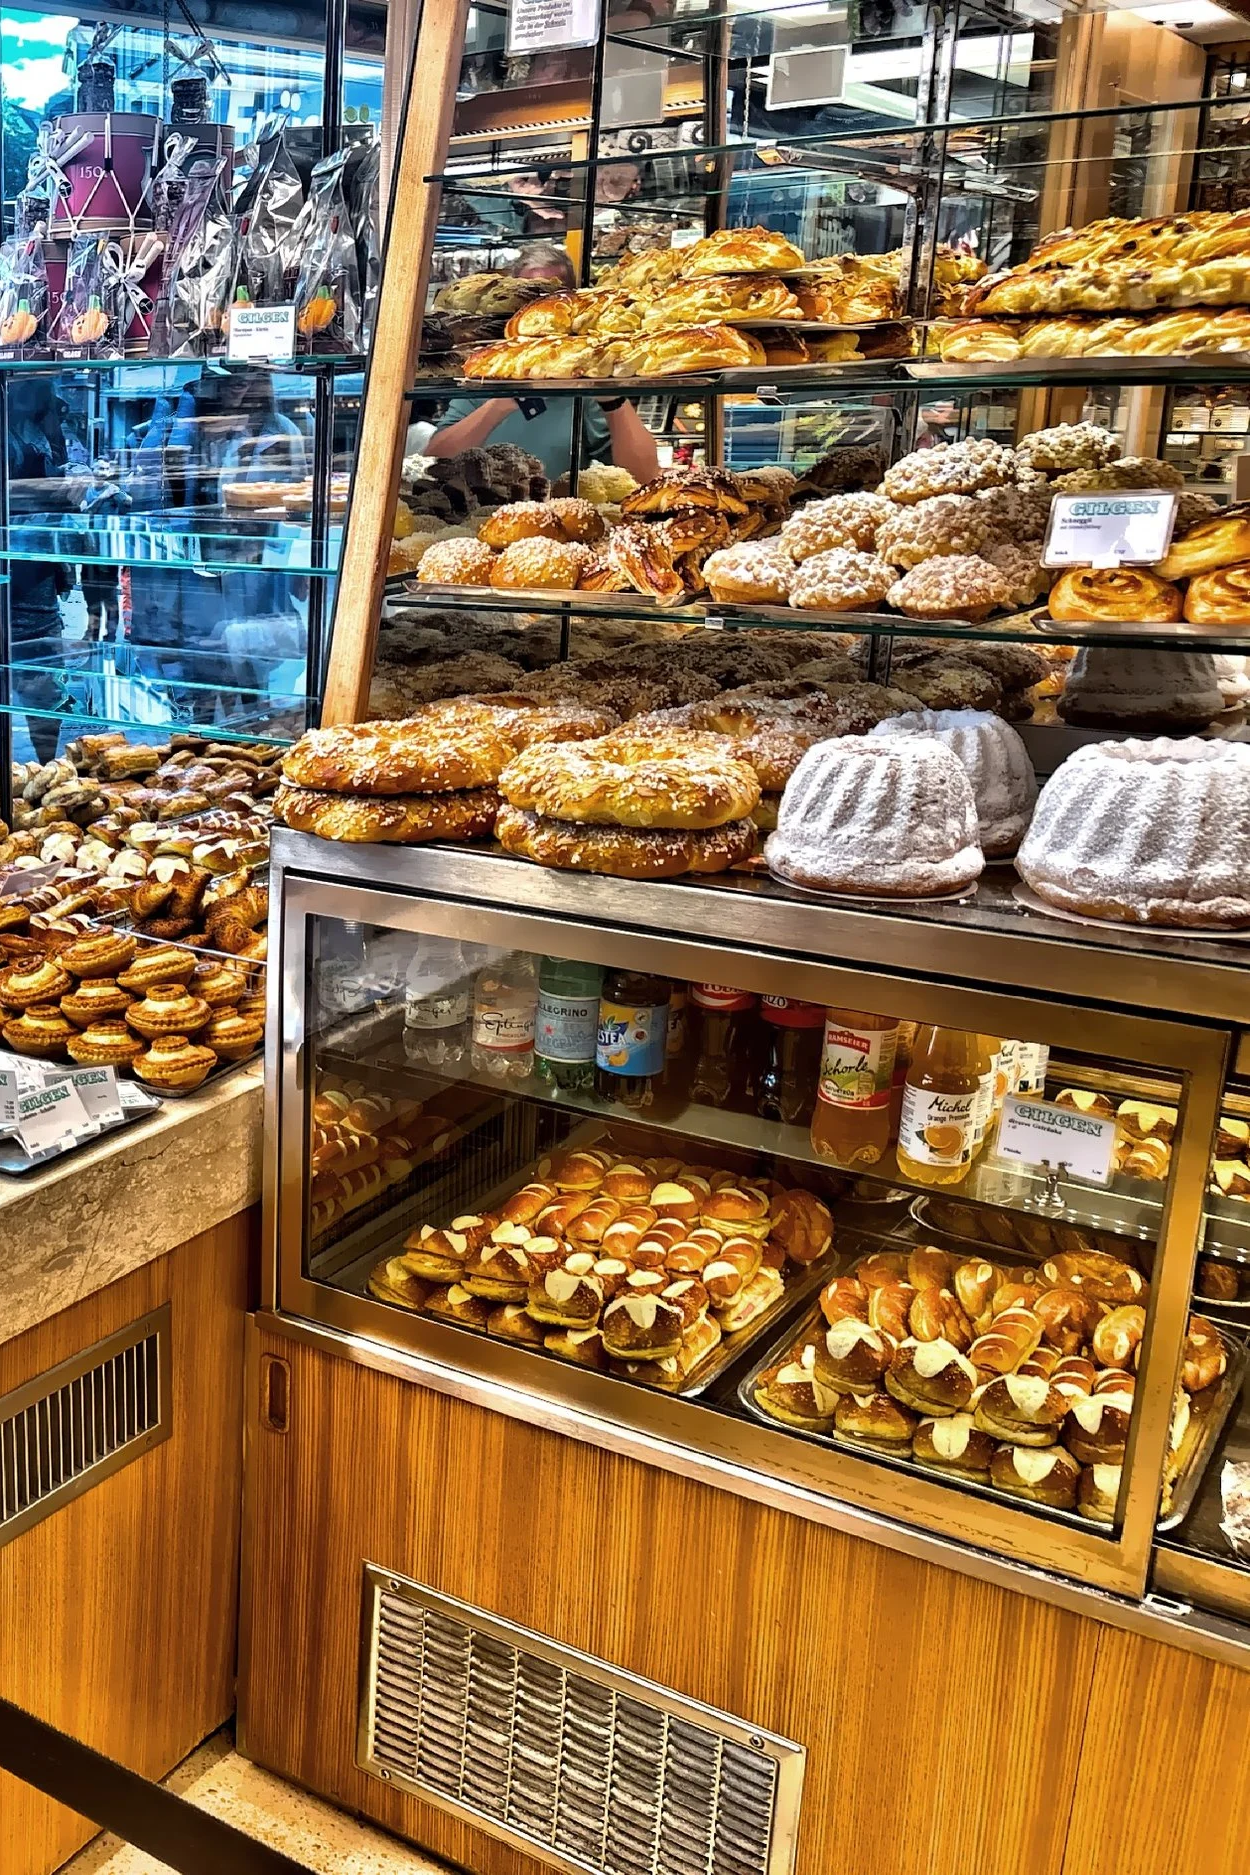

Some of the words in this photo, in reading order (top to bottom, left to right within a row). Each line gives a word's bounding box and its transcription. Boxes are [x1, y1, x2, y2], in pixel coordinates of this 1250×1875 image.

[237, 311, 290, 323] GILGEN
[1070, 500, 1161, 516] GILGEN
[828, 1033, 869, 1051] RAMSEIER
[823, 1055, 869, 1076] Schorle
[19, 1085, 71, 1114] GILGEN
[928, 1096, 974, 1113] Michel
[1015, 1104, 1103, 1137] GILGEN
